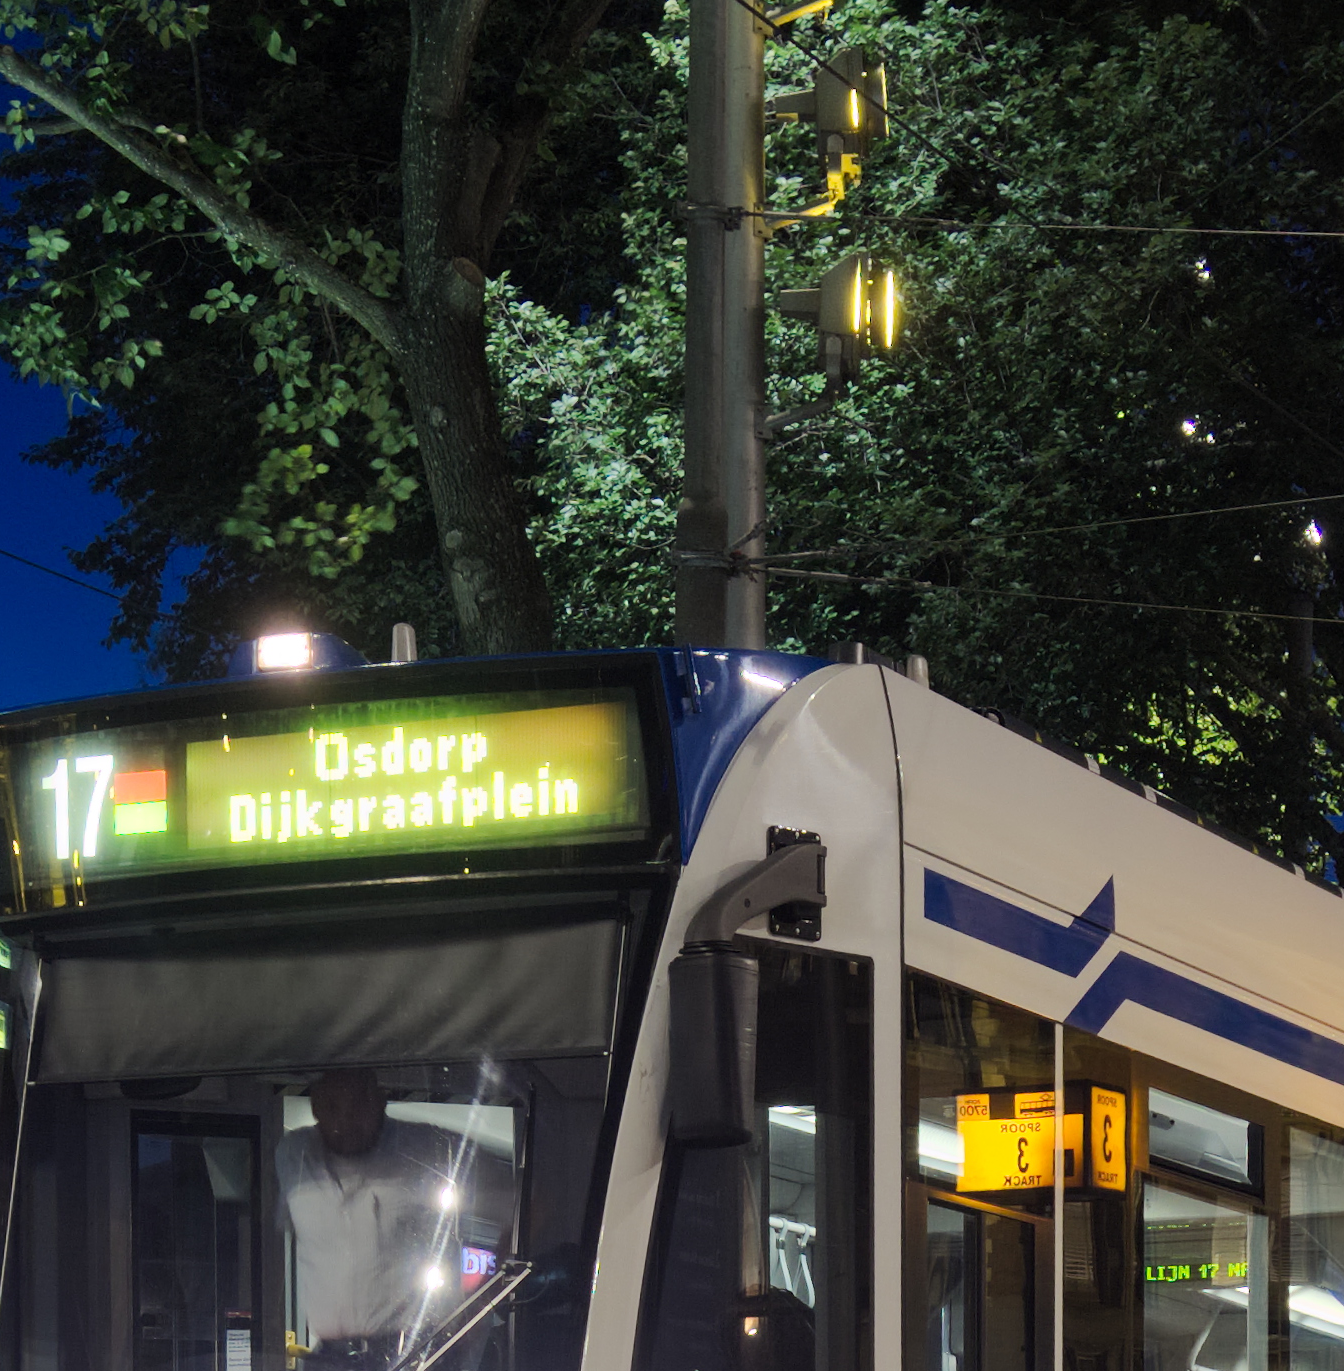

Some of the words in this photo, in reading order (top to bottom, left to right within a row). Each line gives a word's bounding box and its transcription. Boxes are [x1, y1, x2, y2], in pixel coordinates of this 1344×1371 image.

[314, 726, 487, 782] Osdorp
[41, 755, 114, 860] 17
[229, 763, 579, 843] Dijkgraafplein
[462, 1246, 497, 1275] bis
[1146, 1265, 1191, 1282] LIJN
[1198, 1263, 1220, 1278] 17
